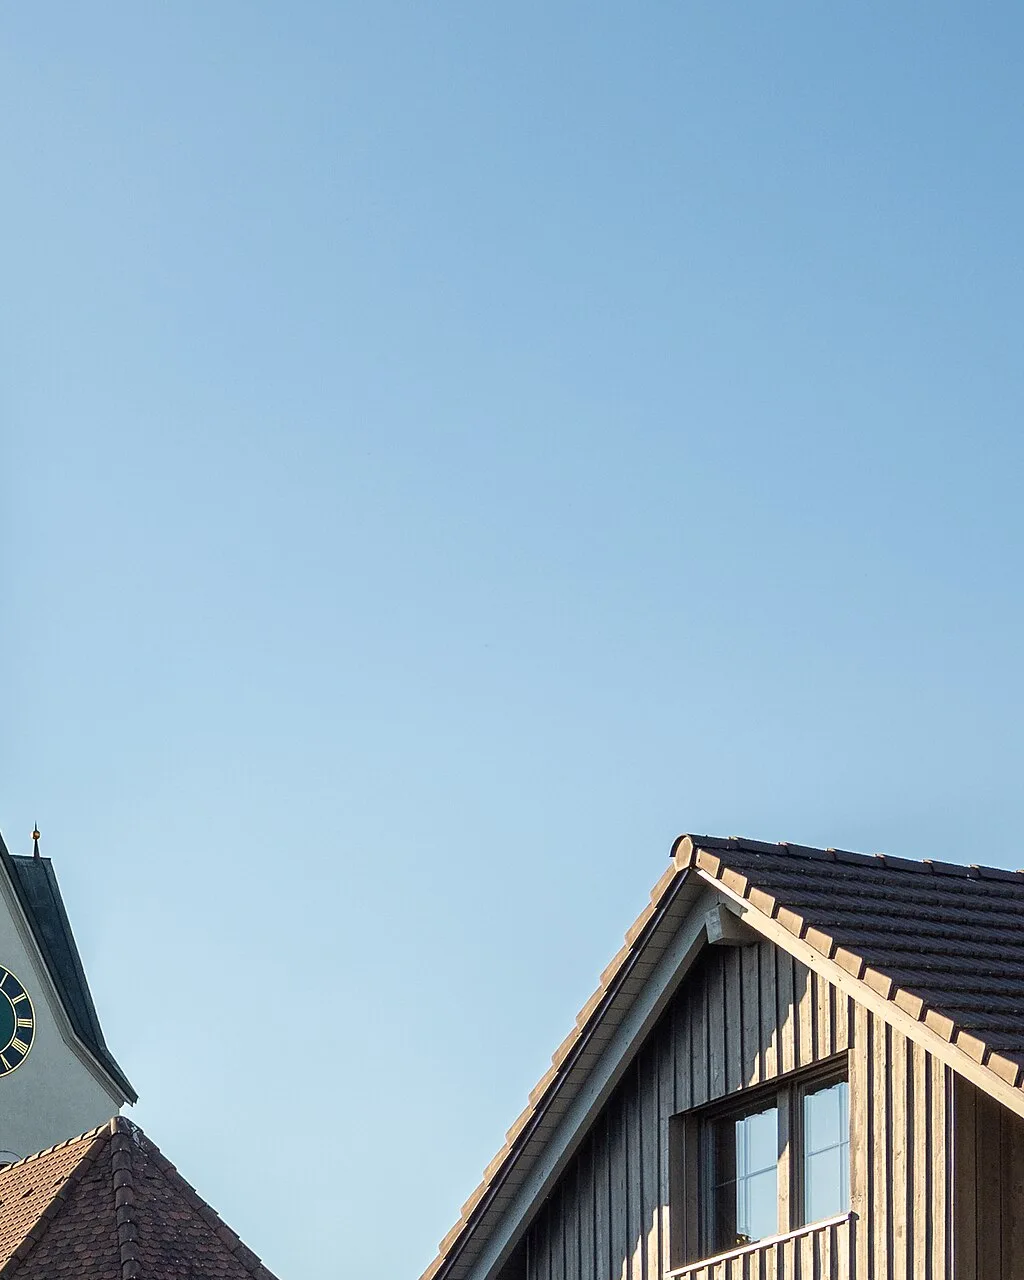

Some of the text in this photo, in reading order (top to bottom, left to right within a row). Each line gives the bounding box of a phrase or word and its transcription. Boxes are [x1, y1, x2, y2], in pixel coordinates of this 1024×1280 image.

[0, 973, 8, 987] I
[12, 993, 26, 1005] II
[18, 1019, 32, 1027] III
[12, 1038, 28, 1055] IIII
[0, 1054, 12, 1070] V
